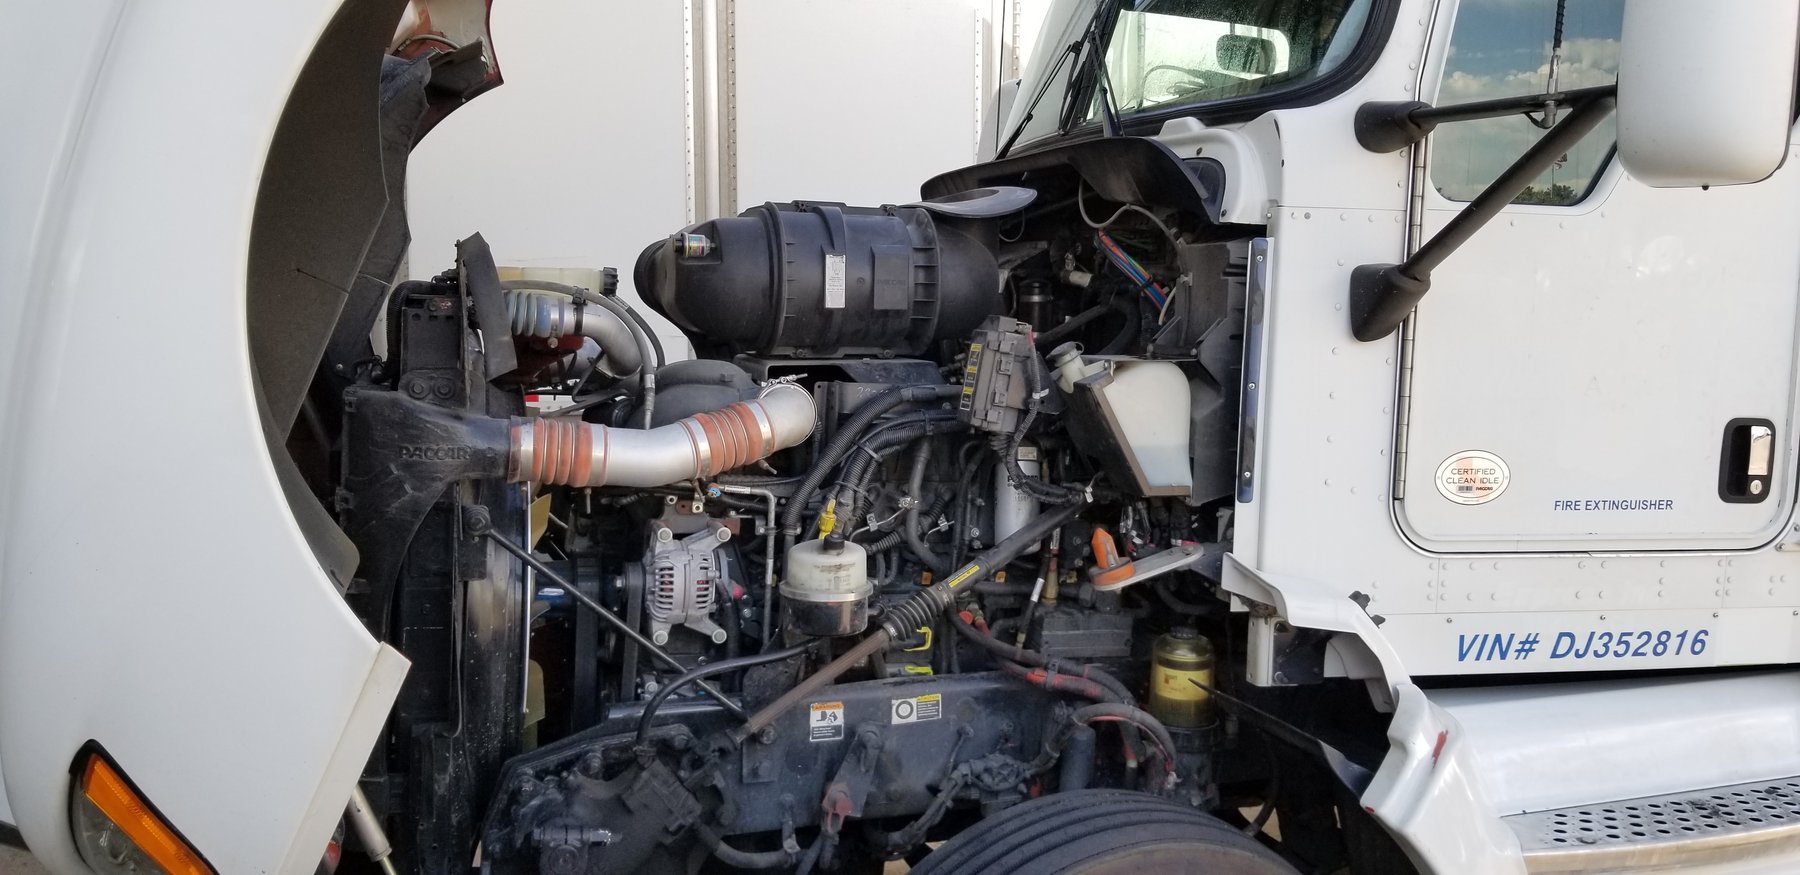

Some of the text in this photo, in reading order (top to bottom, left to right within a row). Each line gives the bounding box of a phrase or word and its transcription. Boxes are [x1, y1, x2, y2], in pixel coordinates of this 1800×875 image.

[1450, 467, 1496, 476] CERTIFIED
[1554, 499, 1674, 511] FIRE EXTINGUISHER
[1457, 629, 1710, 662] VIN# DJ352816
